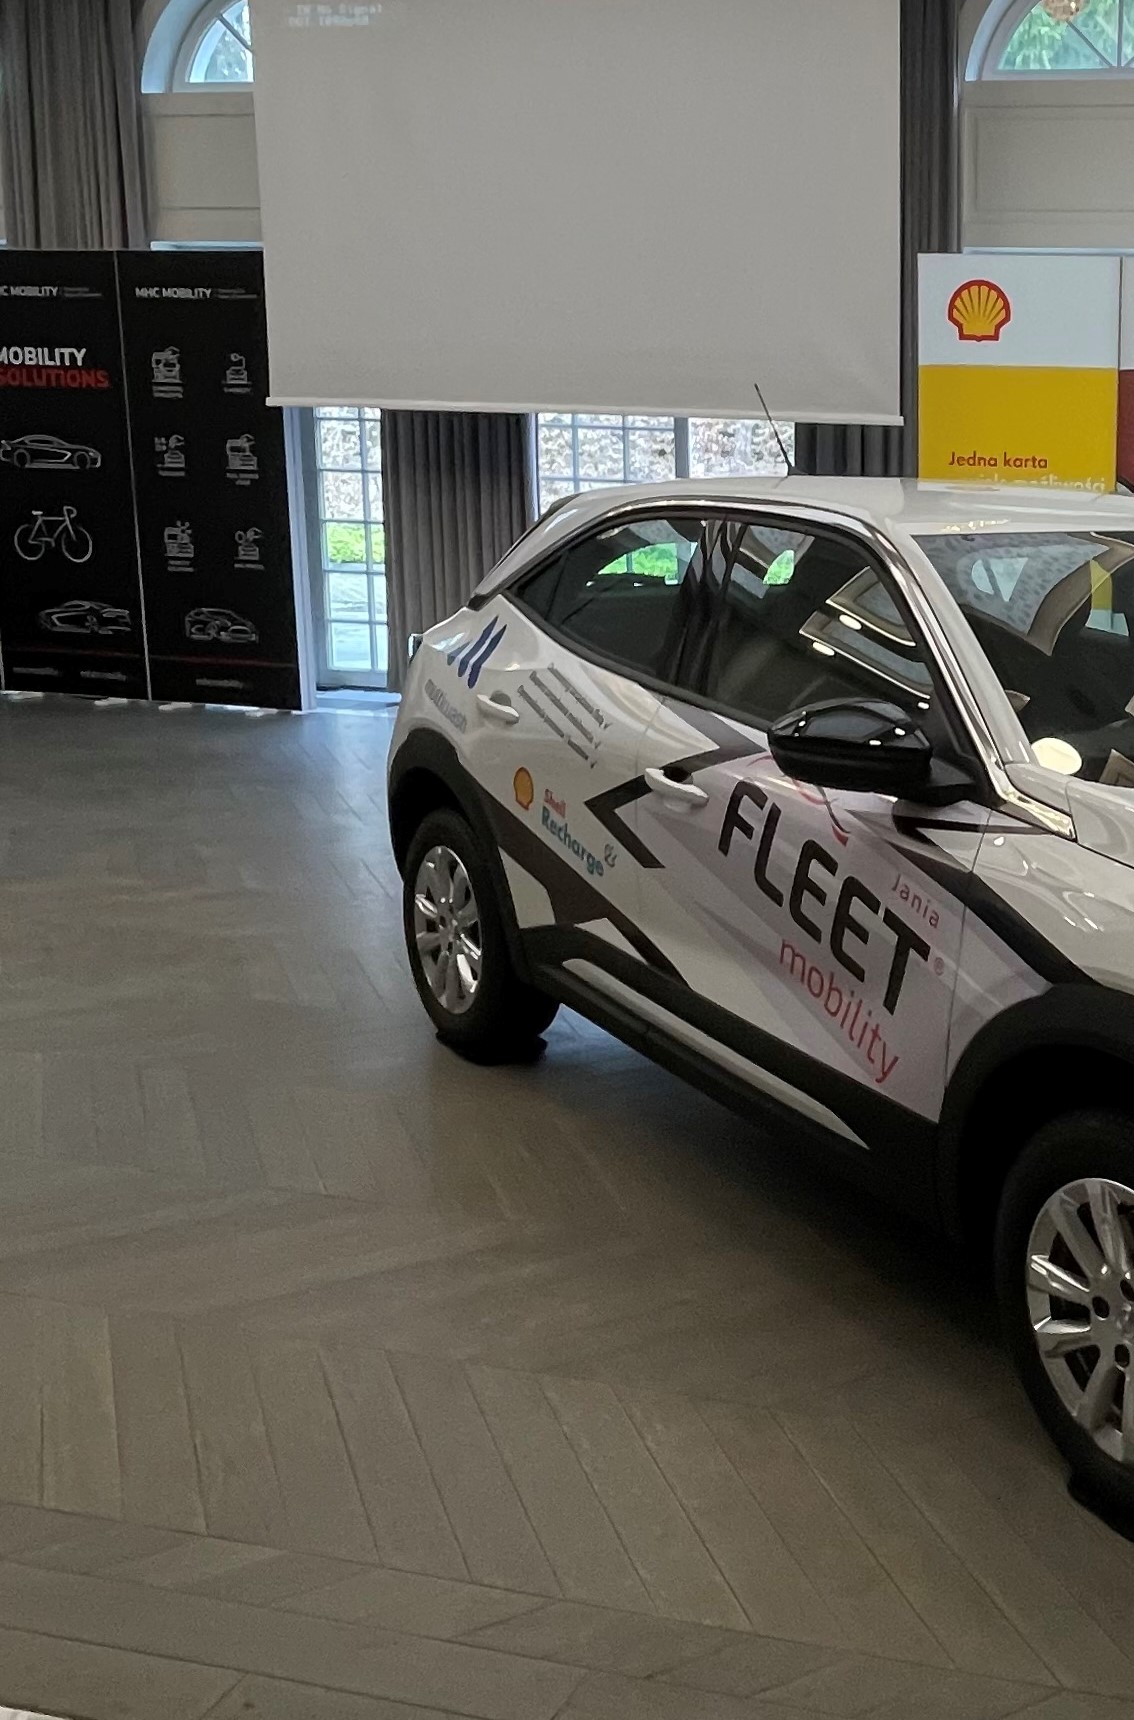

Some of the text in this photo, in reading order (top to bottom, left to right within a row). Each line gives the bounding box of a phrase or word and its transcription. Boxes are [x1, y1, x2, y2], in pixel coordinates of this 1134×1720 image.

[10, 286, 58, 297] MOBILITY
[135, 287, 160, 298] MHC
[162, 287, 212, 299] MOBILITY
[949, 451, 1048, 469] Jedna karta
[544, 788, 567, 819] Shell
[541, 806, 605, 877] Recharge
[718, 780, 931, 1016] FLEET
[891, 874, 940, 930] Jania
[779, 939, 899, 1084] mobility
